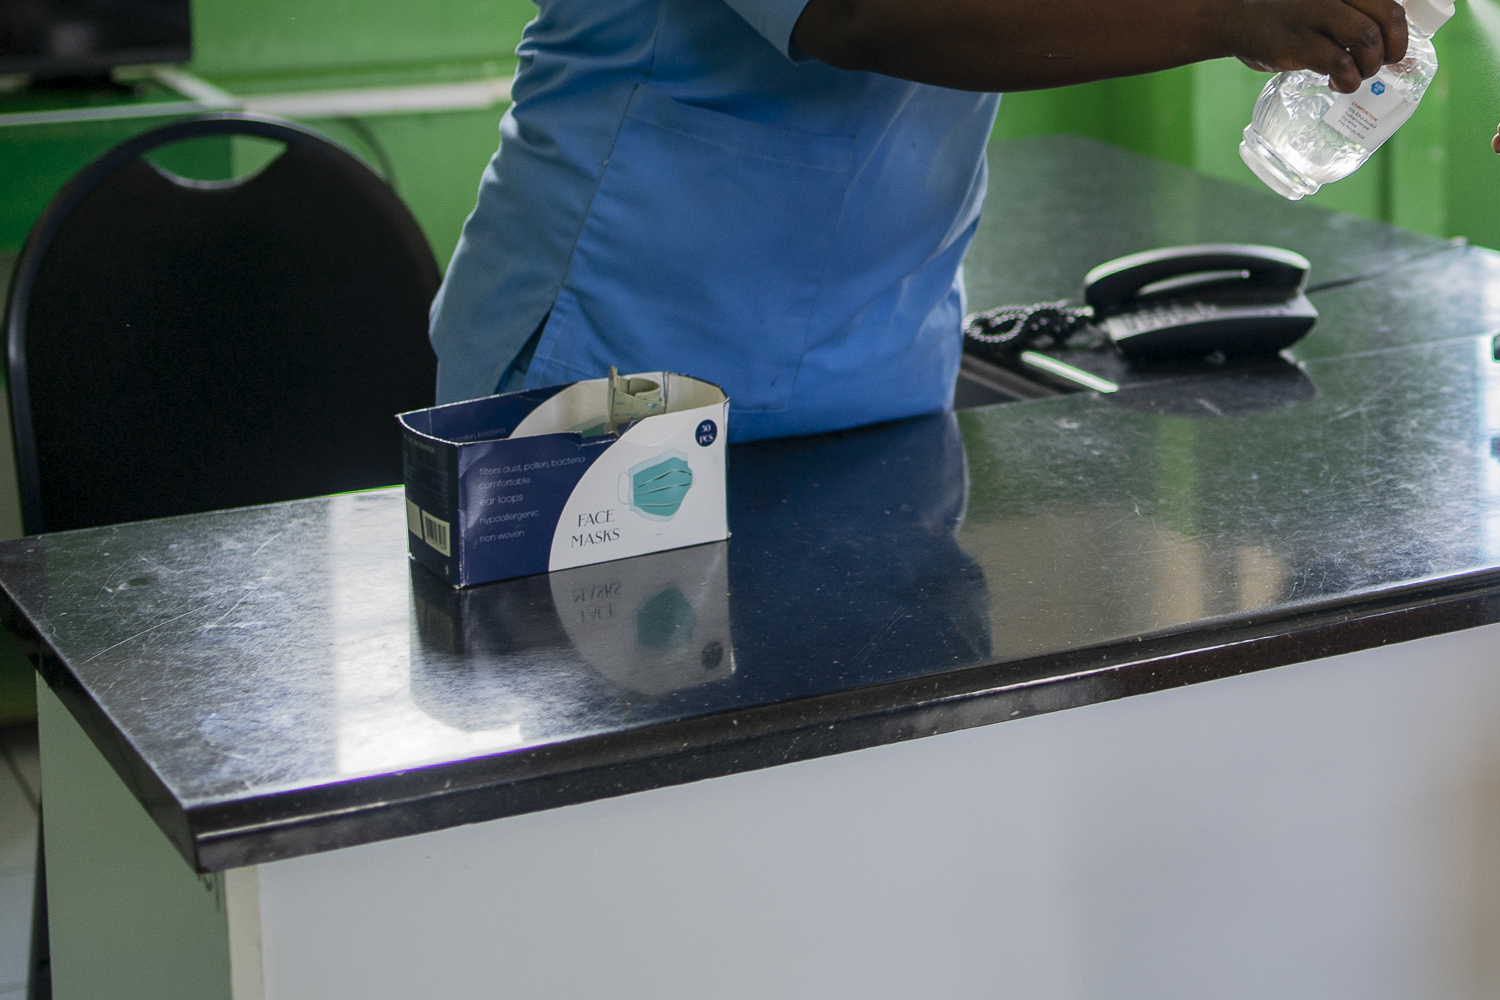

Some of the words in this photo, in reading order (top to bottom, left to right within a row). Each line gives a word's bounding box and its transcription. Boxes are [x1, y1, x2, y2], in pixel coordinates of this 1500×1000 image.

[480, 467, 501, 475] filters
[551, 456, 586, 467] bacteria
[480, 477, 531, 489] comfortable
[497, 494, 524, 505] loops
[577, 509, 616, 528] FACE
[480, 533, 497, 542] non
[497, 530, 525, 540] woven
[571, 527, 620, 549] MASKS
